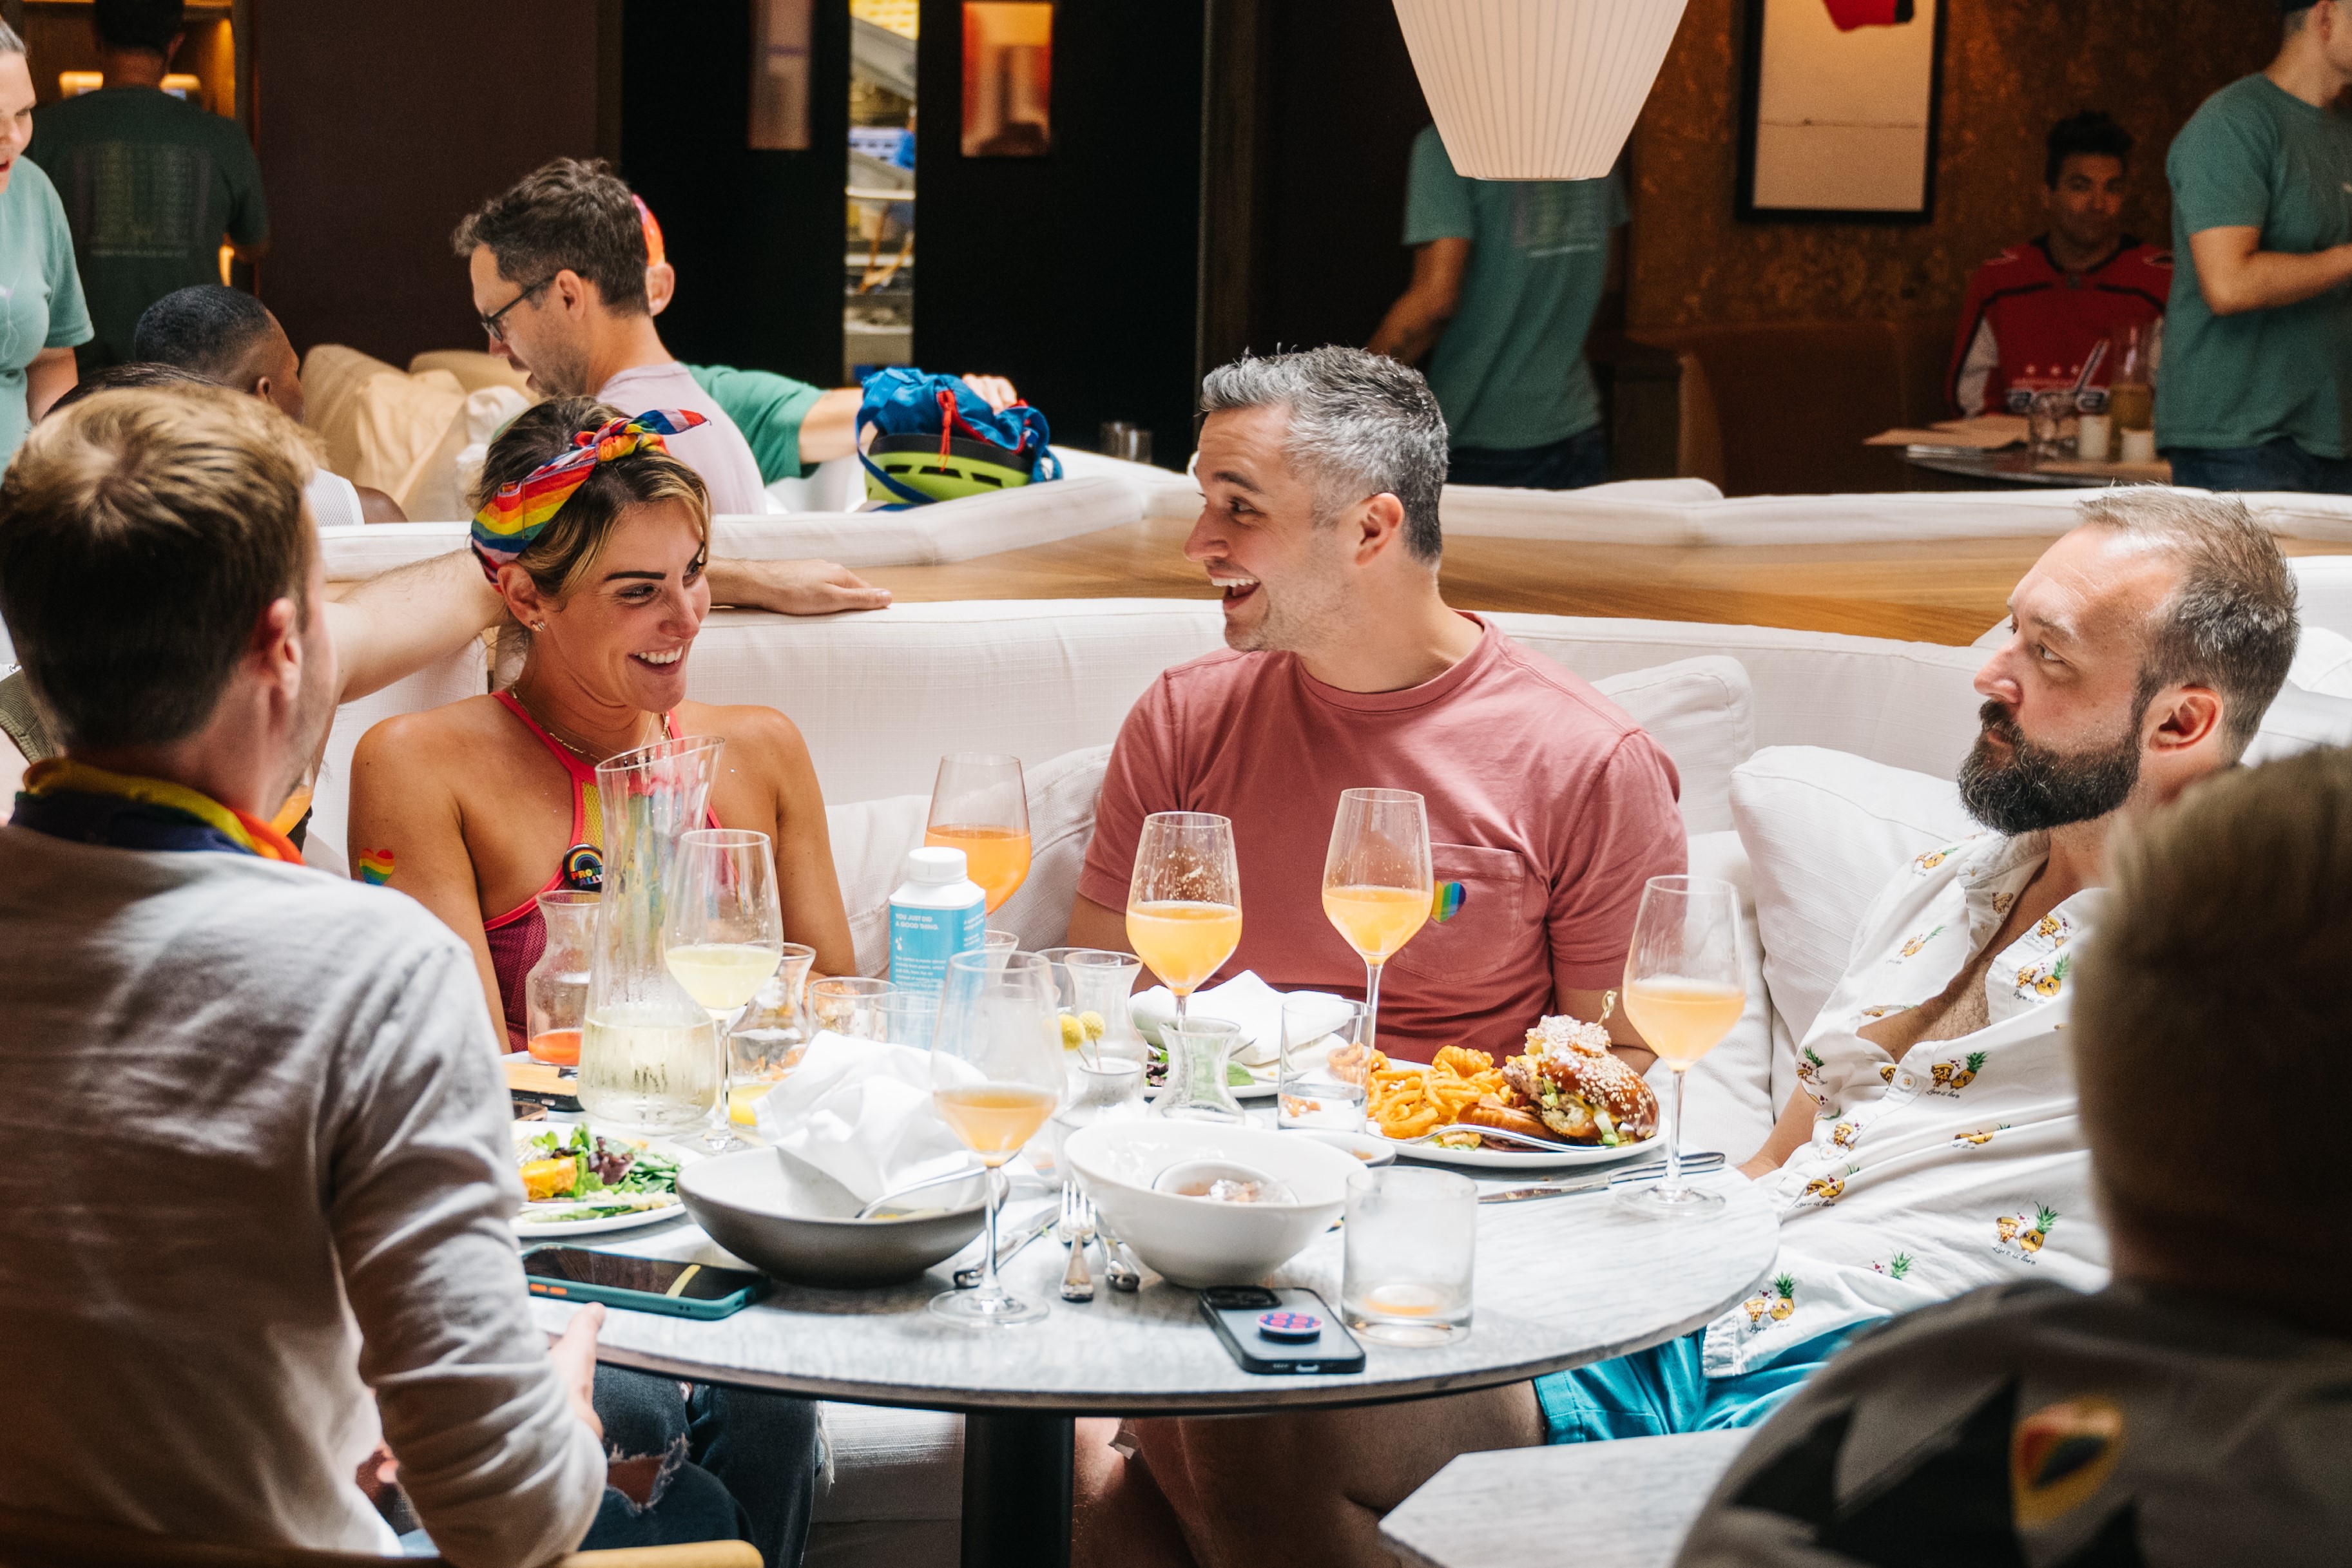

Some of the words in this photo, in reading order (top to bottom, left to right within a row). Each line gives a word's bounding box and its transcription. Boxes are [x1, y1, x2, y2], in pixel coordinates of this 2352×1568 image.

[579, 874, 603, 886] ALLY
[1992, 1243, 2011, 1254] Love
[2020, 1254, 2036, 1265] love
